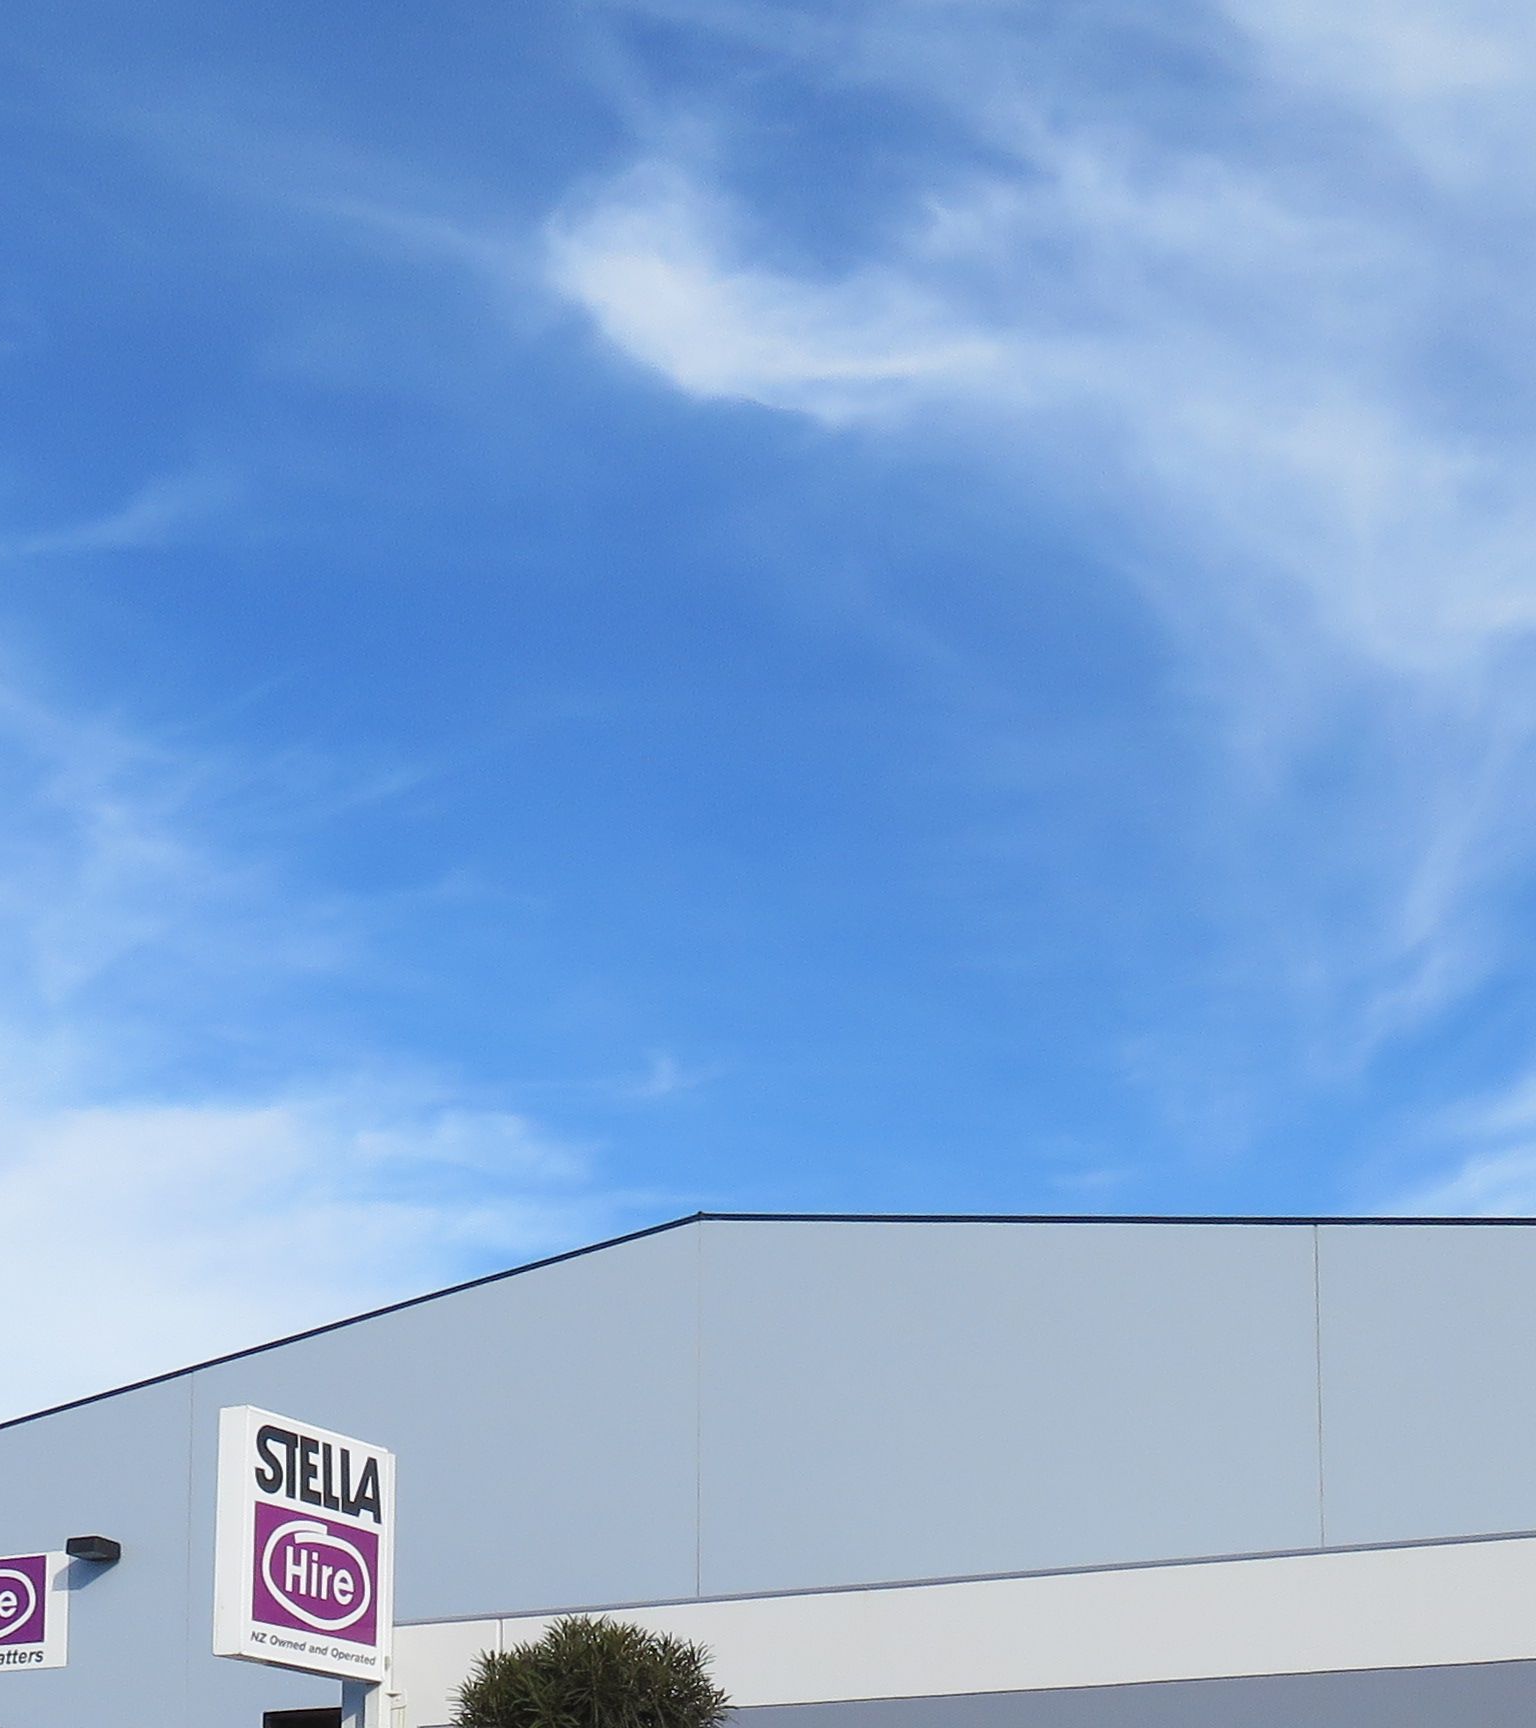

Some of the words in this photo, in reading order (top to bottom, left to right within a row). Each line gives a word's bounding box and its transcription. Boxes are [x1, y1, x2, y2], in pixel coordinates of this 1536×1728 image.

[255, 1424, 382, 1525] STELLA
[284, 1545, 355, 1606] Hire
[250, 1631, 267, 1644] NZ
[269, 1635, 306, 1652] Owned
[308, 1646, 329, 1656] and
[331, 1647, 376, 1666] Operated
